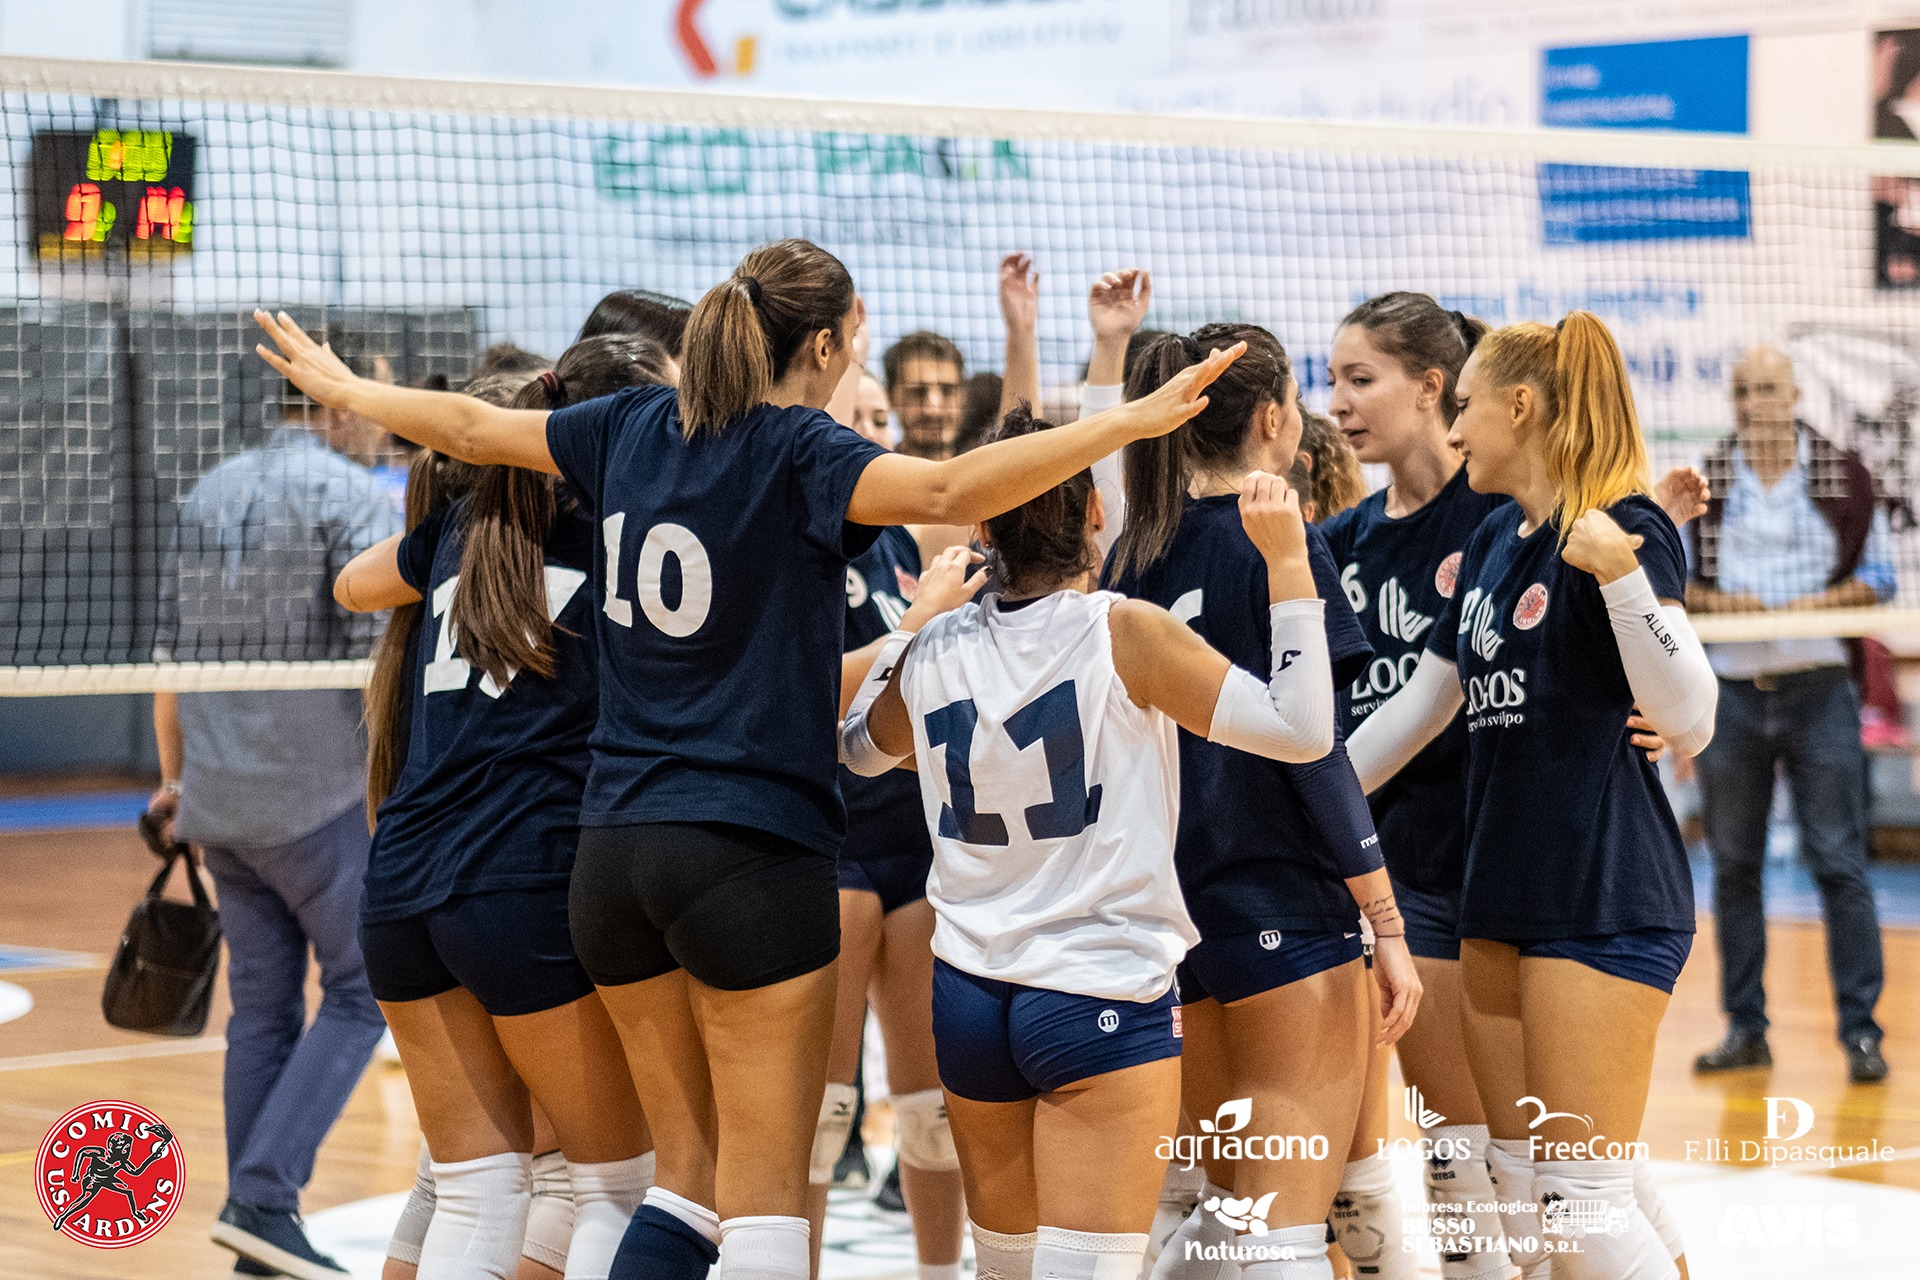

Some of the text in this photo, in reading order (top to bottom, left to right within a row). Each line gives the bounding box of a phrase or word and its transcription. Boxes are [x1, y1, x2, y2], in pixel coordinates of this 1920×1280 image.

[602, 511, 713, 638] 10
[1642, 613, 1679, 657] ALLSIX
[1351, 652, 1420, 699] LOG
[1464, 668, 1525, 715] OOS
[924, 679, 1103, 847] 11
